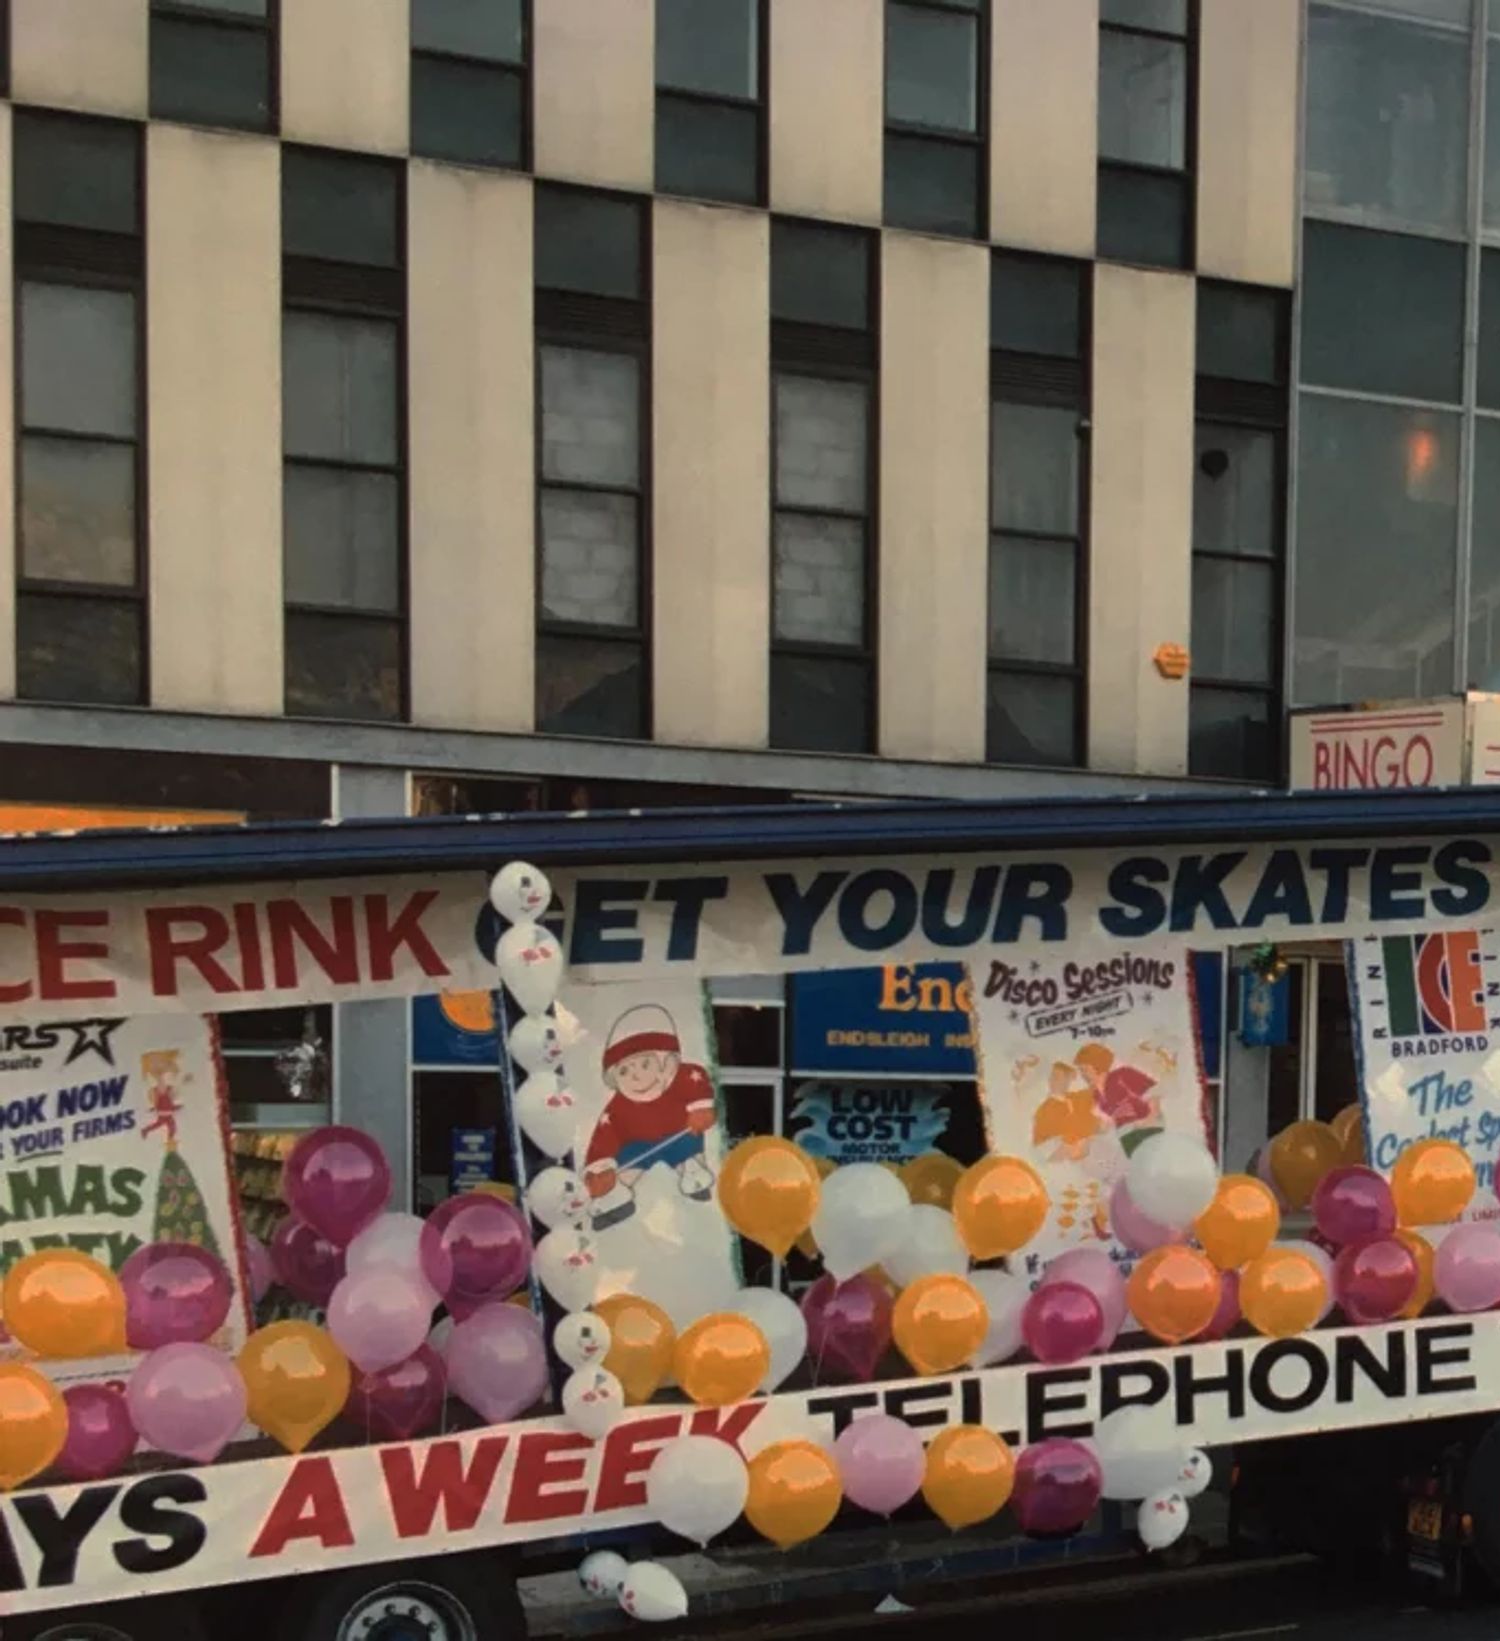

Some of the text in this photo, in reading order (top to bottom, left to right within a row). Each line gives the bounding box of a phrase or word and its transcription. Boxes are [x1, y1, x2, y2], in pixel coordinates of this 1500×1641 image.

[1313, 734, 1433, 790] BINGO
[145, 889, 450, 996] RINK
[764, 862, 1074, 956] YOUR
[1099, 839, 1492, 938] SKATES
[984, 952, 1175, 1007] Disco Sessions
[1036, 1009, 1076, 1030] EVERY
[1392, 1036, 1488, 1057] BRADFORD
[56, 1075, 129, 1119] NOW
[831, 1088, 913, 1113] LOW
[1407, 1070, 1474, 1116] The
[11, 1127, 64, 1156] YOUR
[72, 1109, 136, 1142] FIRMS
[826, 1115, 917, 1140] COST
[0, 1164, 147, 1227] MAS
[0, 1473, 208, 1592] YS
[248, 1456, 355, 1558] A
